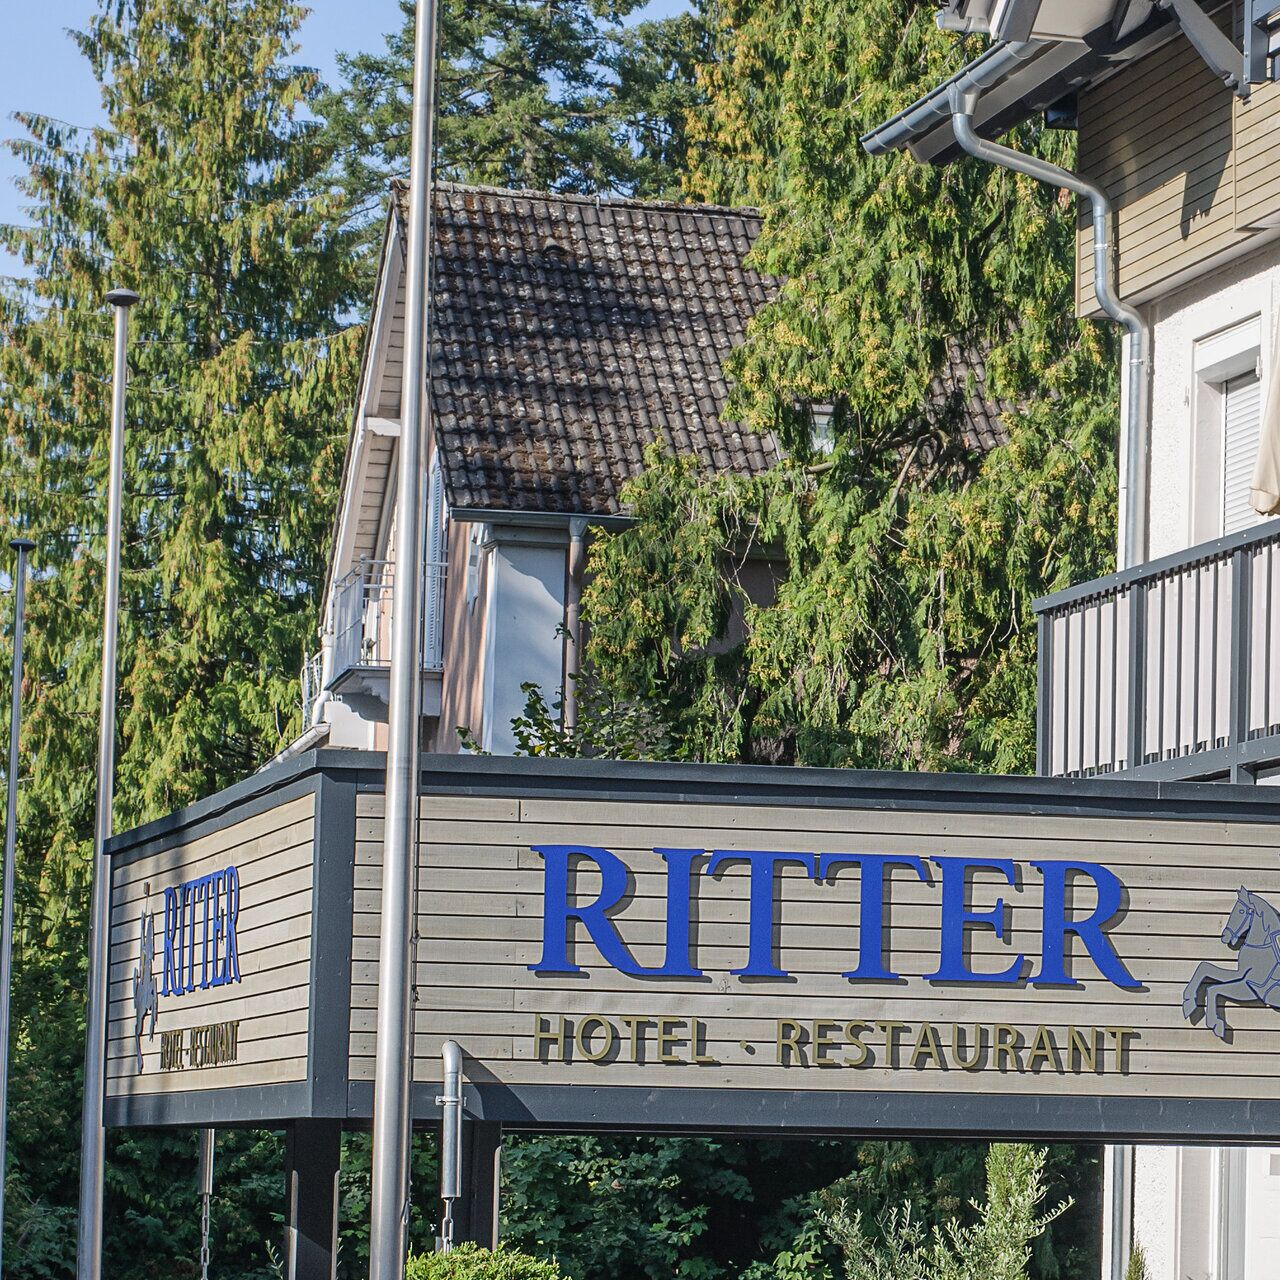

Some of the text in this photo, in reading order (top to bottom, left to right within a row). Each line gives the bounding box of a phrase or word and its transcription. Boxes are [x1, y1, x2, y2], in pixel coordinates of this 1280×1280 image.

[160, 865, 241, 997] RITTER
[527, 844, 1143, 990] RITTER
[533, 1014, 1135, 1071] HOTEL RESTAURANT
